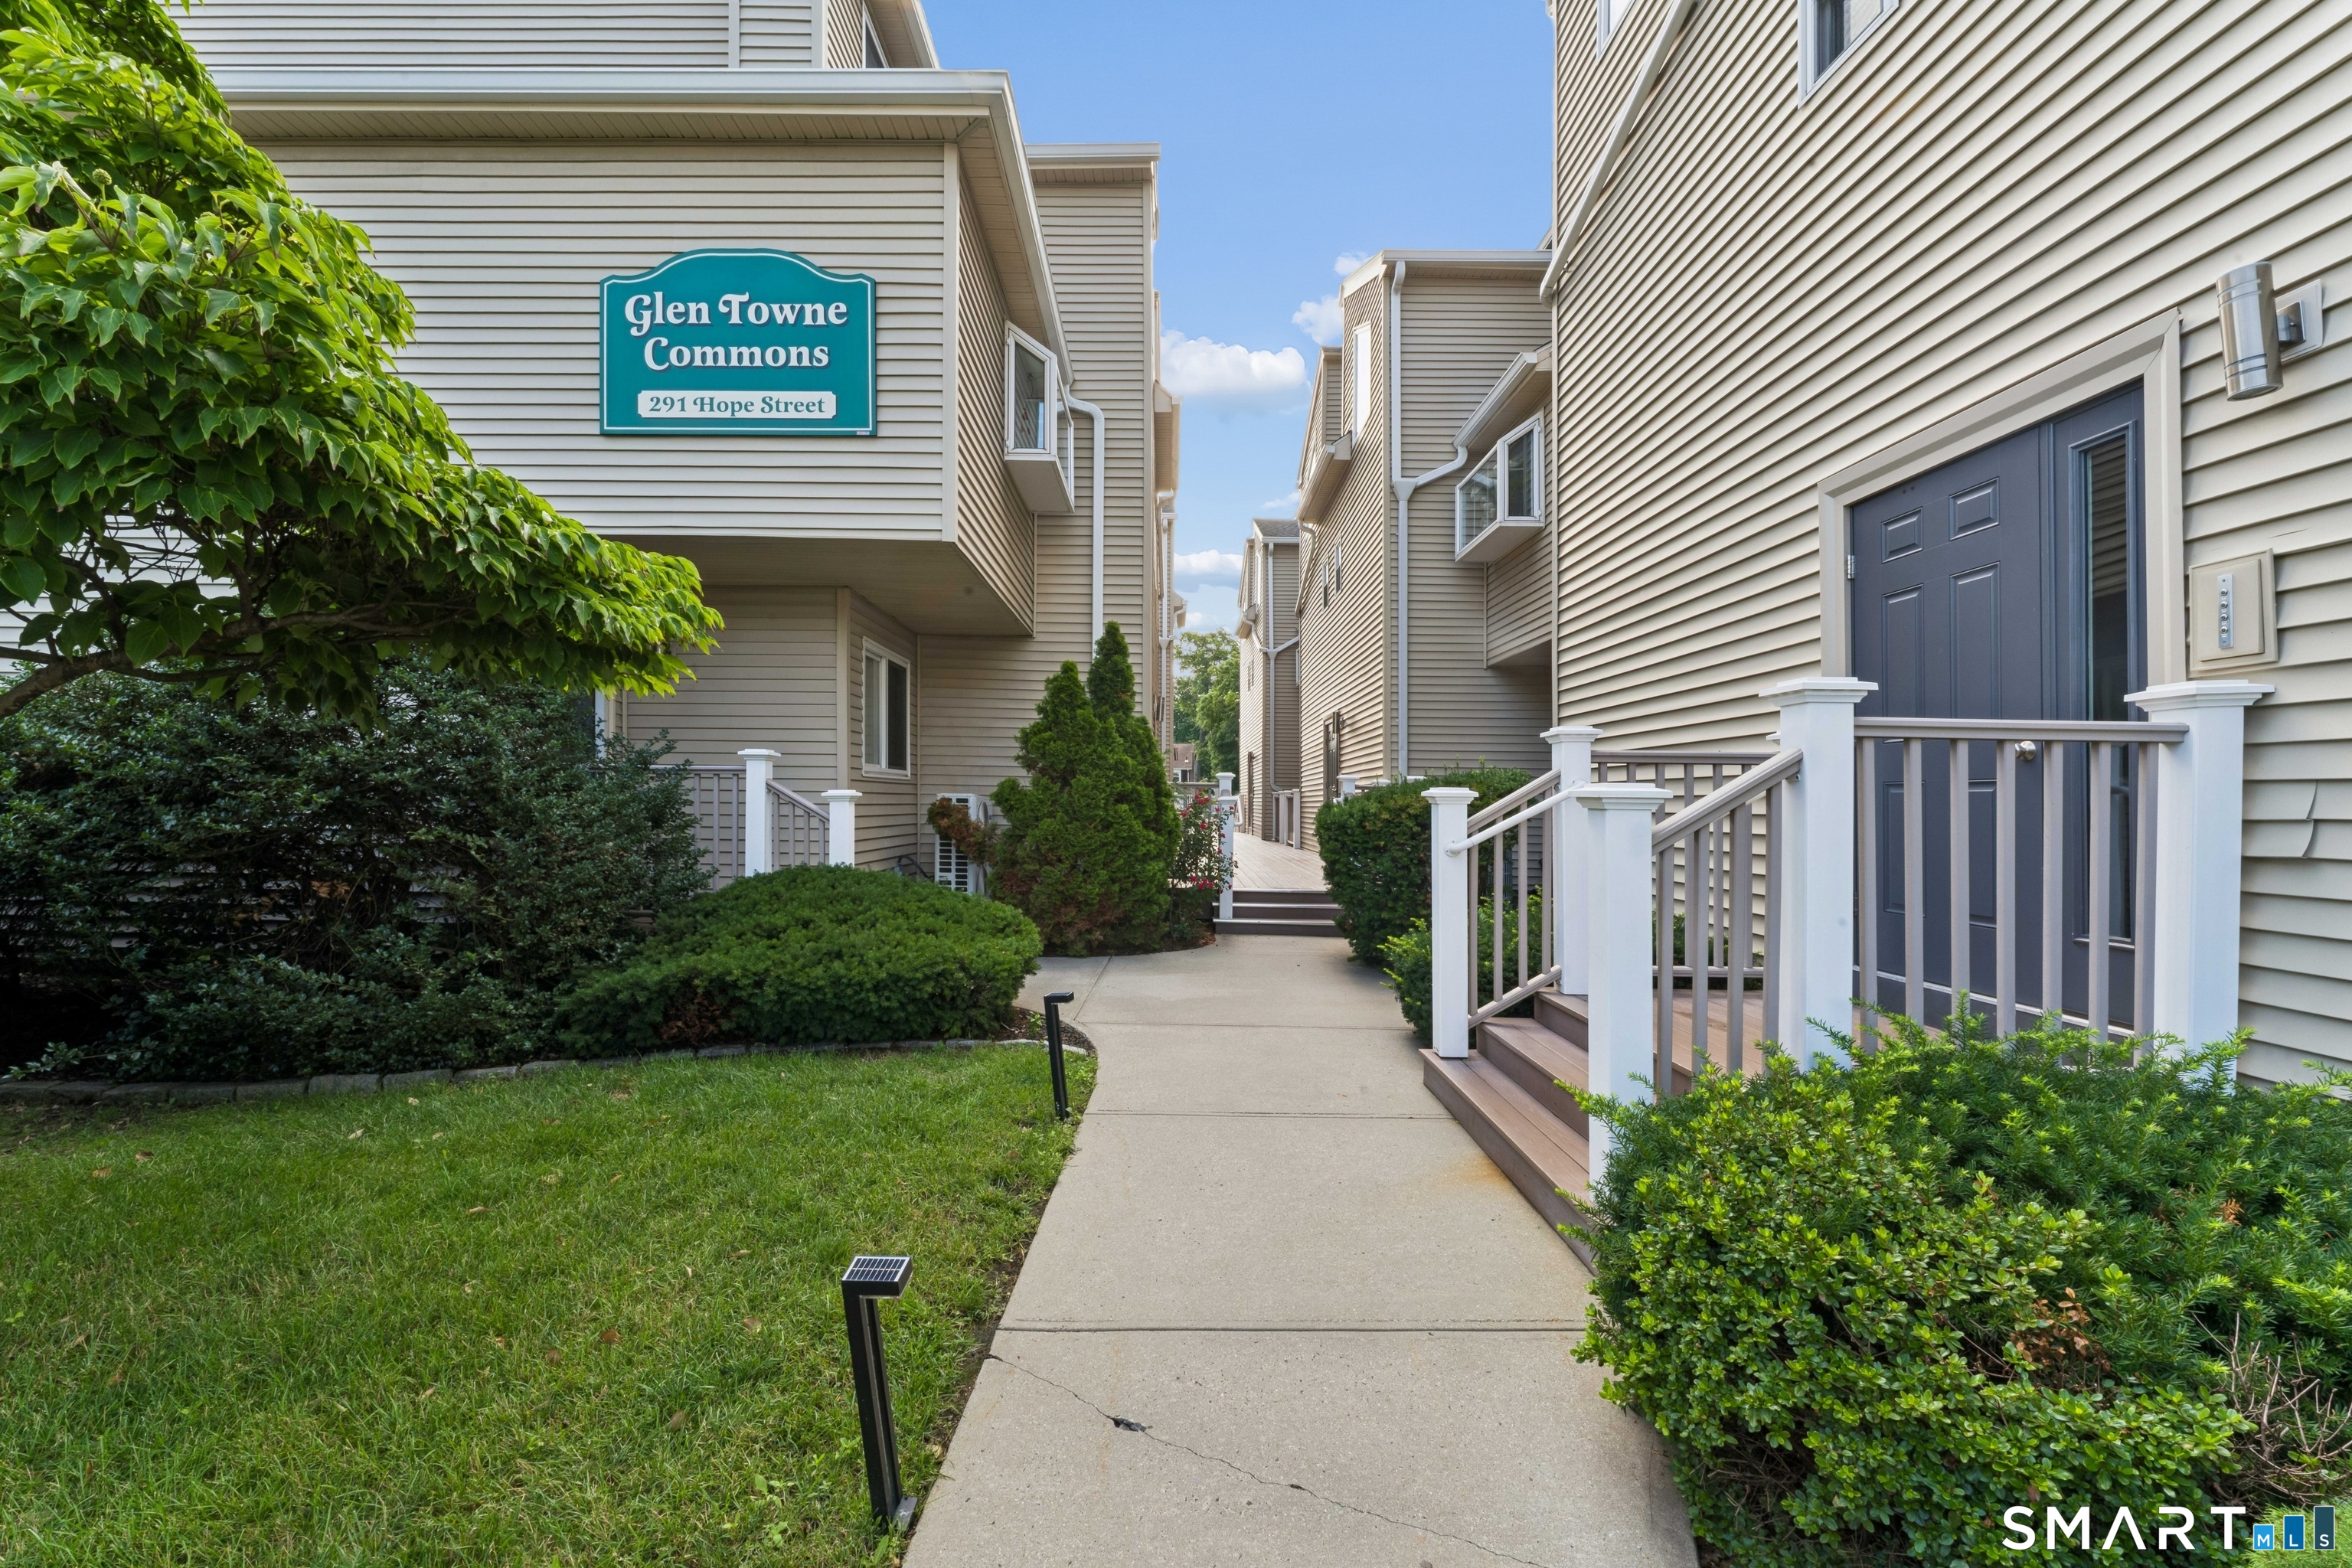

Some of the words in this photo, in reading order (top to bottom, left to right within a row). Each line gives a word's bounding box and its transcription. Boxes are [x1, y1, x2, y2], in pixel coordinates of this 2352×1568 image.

[625, 291, 711, 337] Glen
[718, 292, 848, 325] Towne
[644, 337, 829, 371] Commons
[648, 396, 687, 413] 291
[692, 396, 755, 416] Hope
[760, 396, 825, 414] Street
